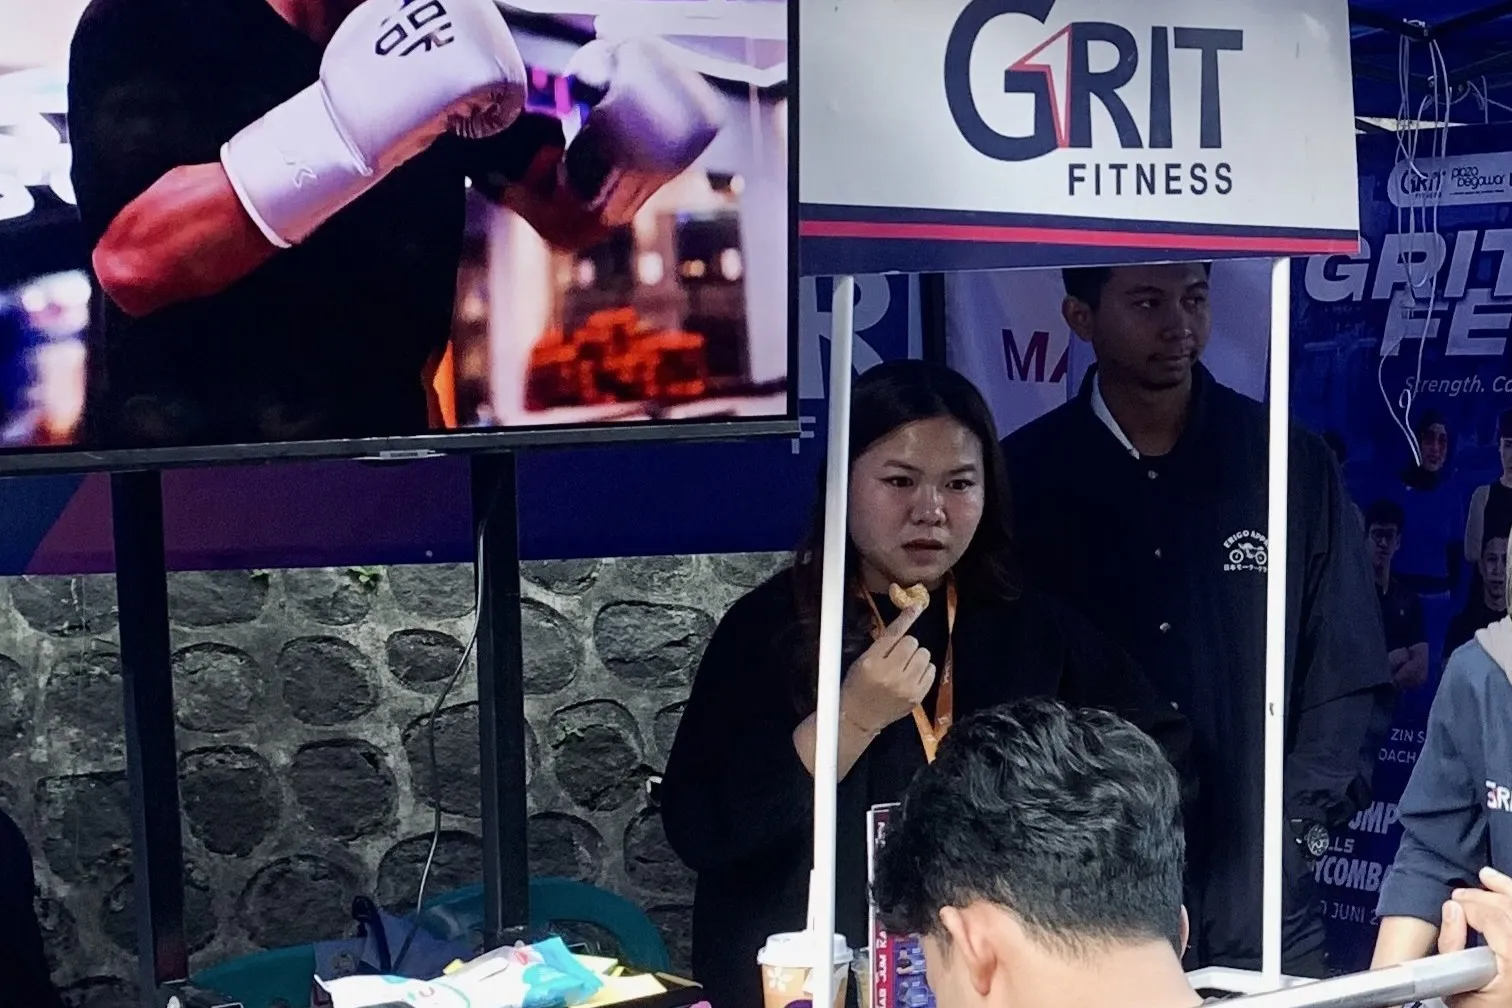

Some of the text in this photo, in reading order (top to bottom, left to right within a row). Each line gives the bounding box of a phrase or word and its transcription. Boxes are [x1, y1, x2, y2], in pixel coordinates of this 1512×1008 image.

[944, 0, 1244, 162] GRIT
[1068, 161, 1234, 196] FITNESS
[1405, 374, 1486, 397] Strength.
